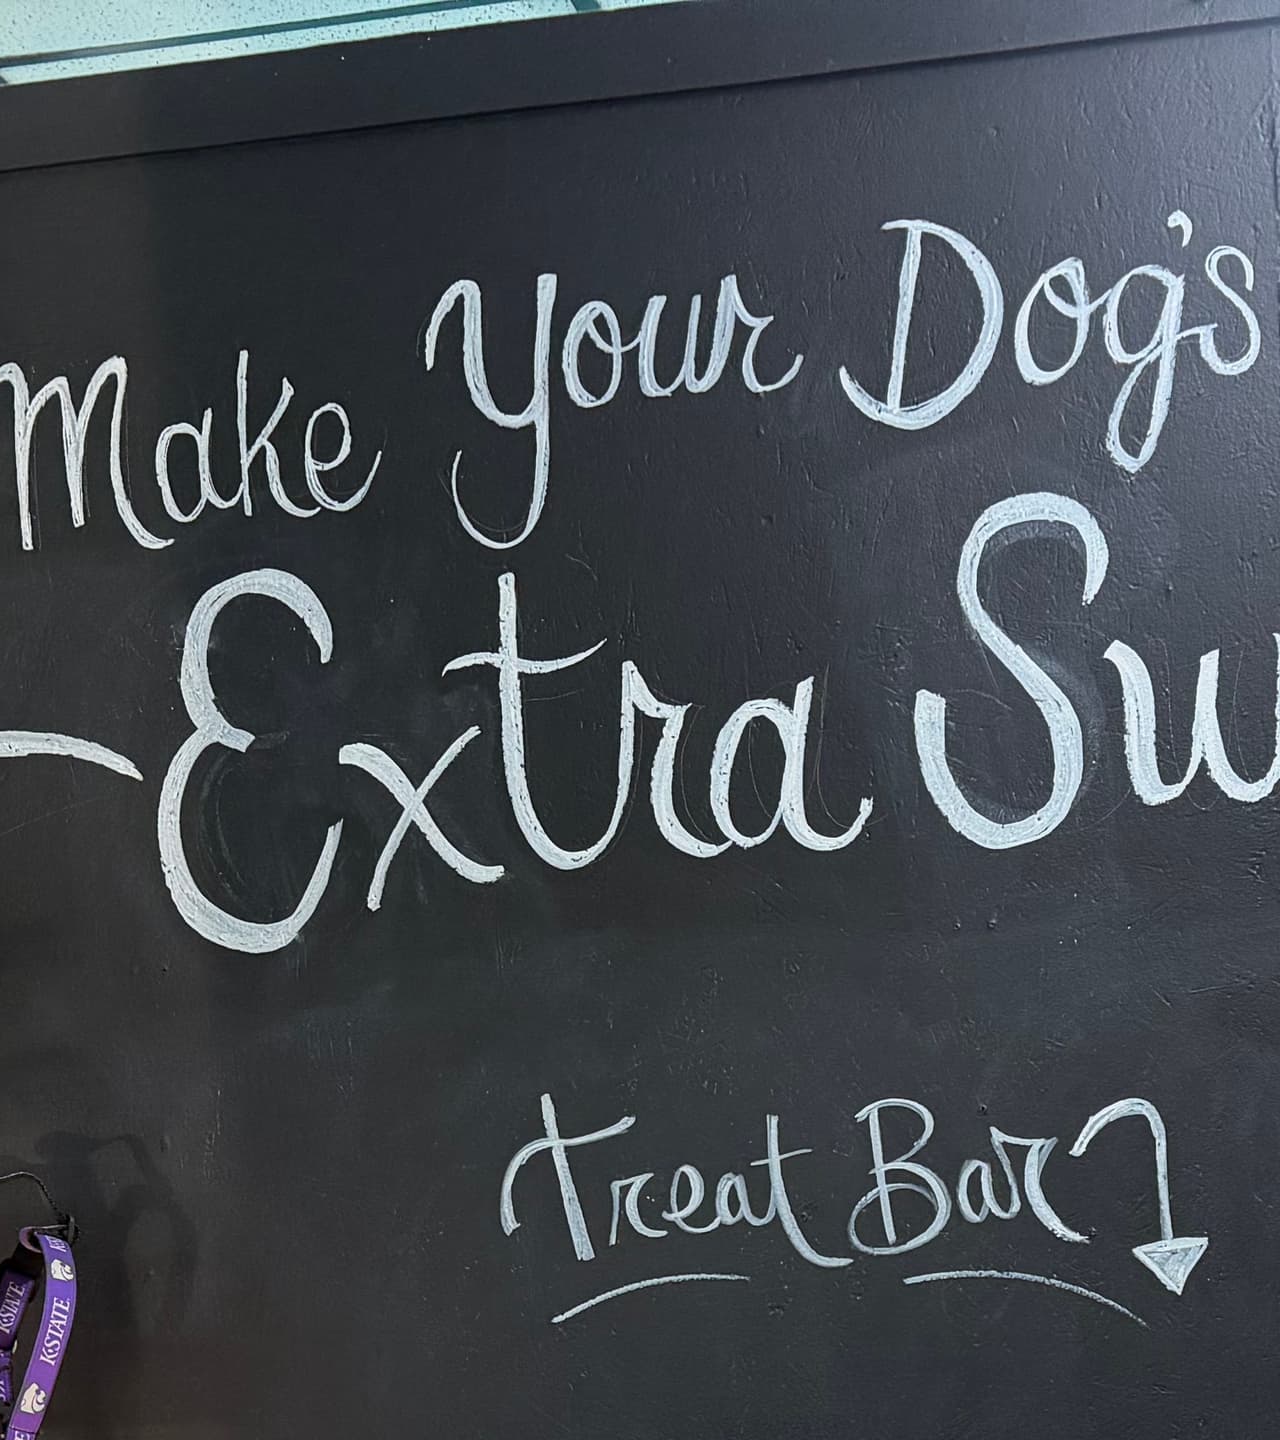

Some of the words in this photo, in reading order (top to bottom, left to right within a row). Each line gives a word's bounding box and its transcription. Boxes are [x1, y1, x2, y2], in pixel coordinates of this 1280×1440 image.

[425, 272, 803, 549] Your
[839, 210, 1262, 472] Dog's
[157, 567, 874, 955] Extra
[500, 1093, 854, 1268] Treat
[847, 1098, 1091, 1256] Bar
